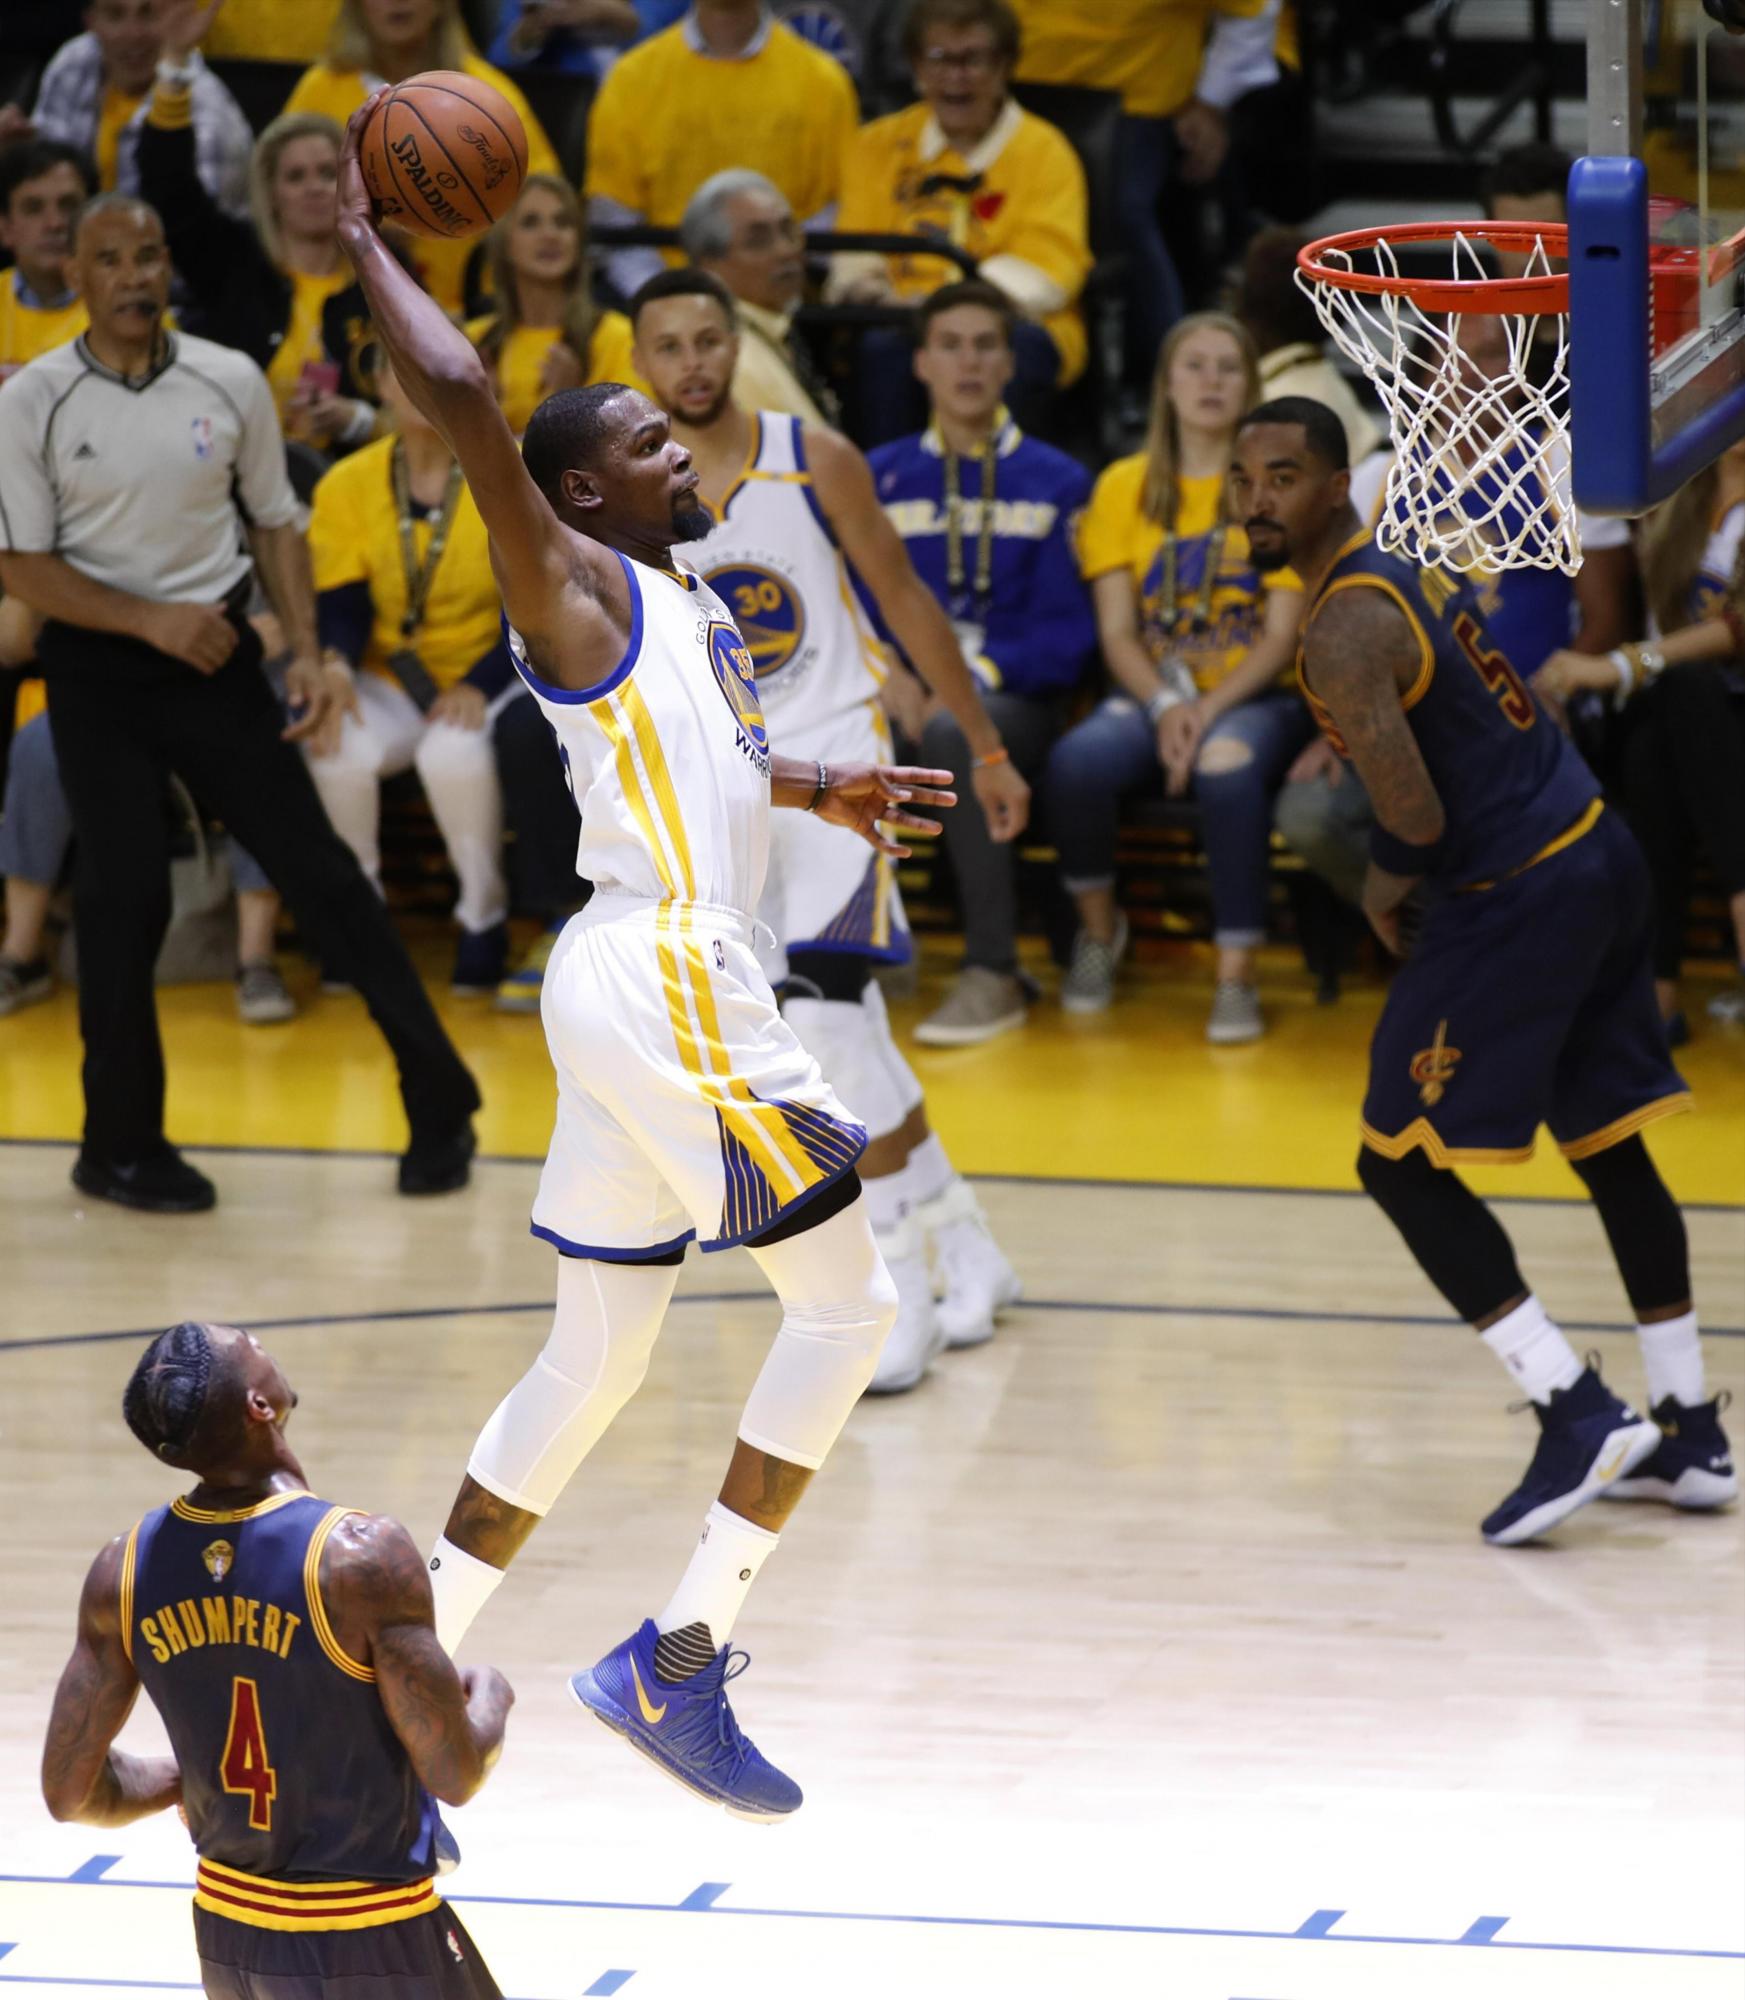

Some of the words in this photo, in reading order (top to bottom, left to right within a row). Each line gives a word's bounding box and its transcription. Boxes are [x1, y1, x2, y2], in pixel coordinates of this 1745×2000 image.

[391, 133, 473, 230] SPALDING
[734, 580, 782, 617] 30
[731, 648, 752, 680] 35
[1453, 611, 1536, 731] 5
[140, 1596, 301, 1663] SHUMPERT
[220, 1676, 276, 1831] 4
